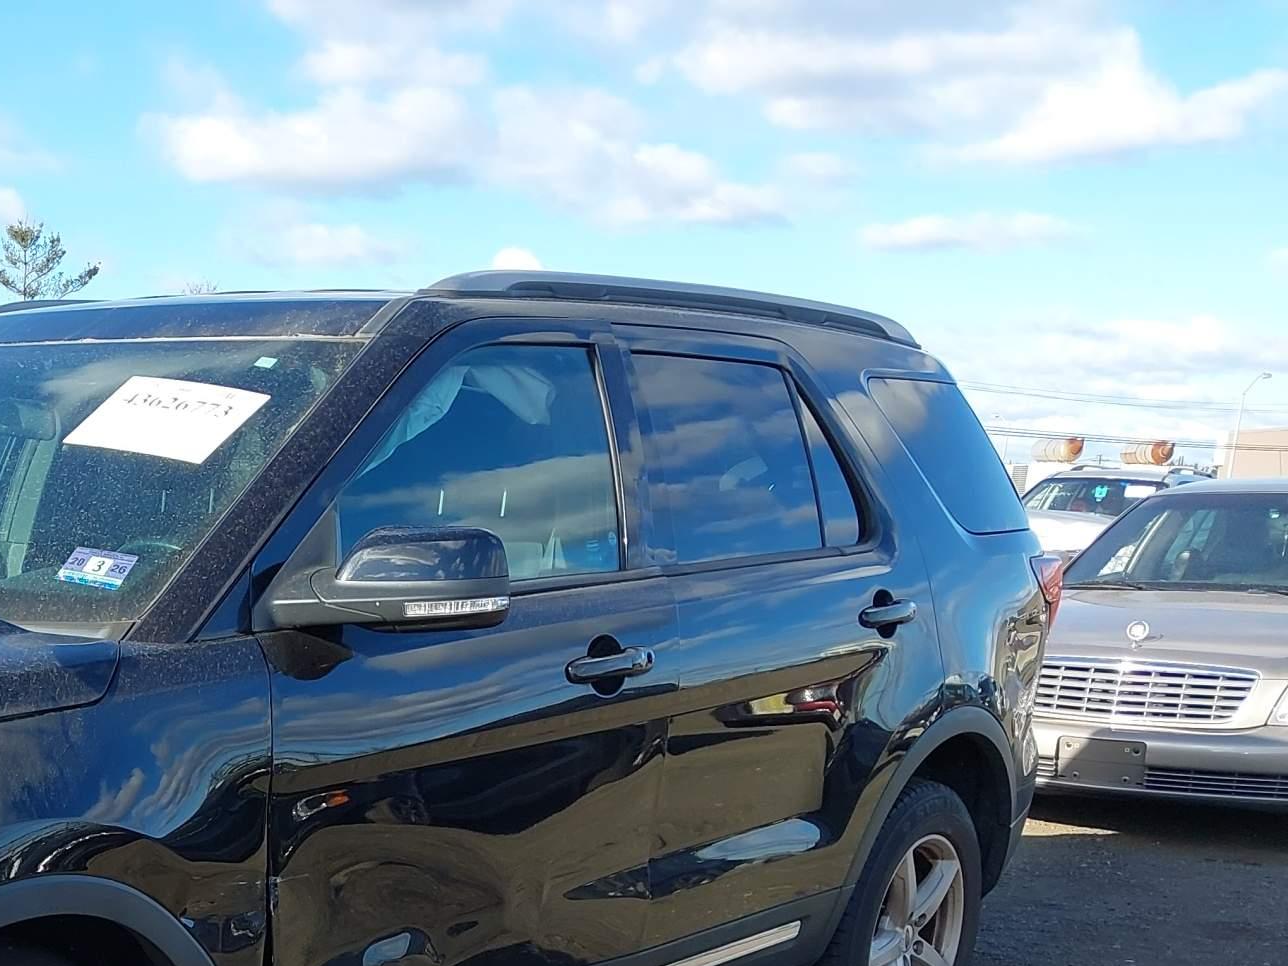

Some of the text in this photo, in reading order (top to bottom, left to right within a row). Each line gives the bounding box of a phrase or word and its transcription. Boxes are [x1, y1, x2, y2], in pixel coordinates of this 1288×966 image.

[123, 392, 234, 418] 43626773
[92, 560, 106, 573] 3
[111, 564, 128, 575] 26
